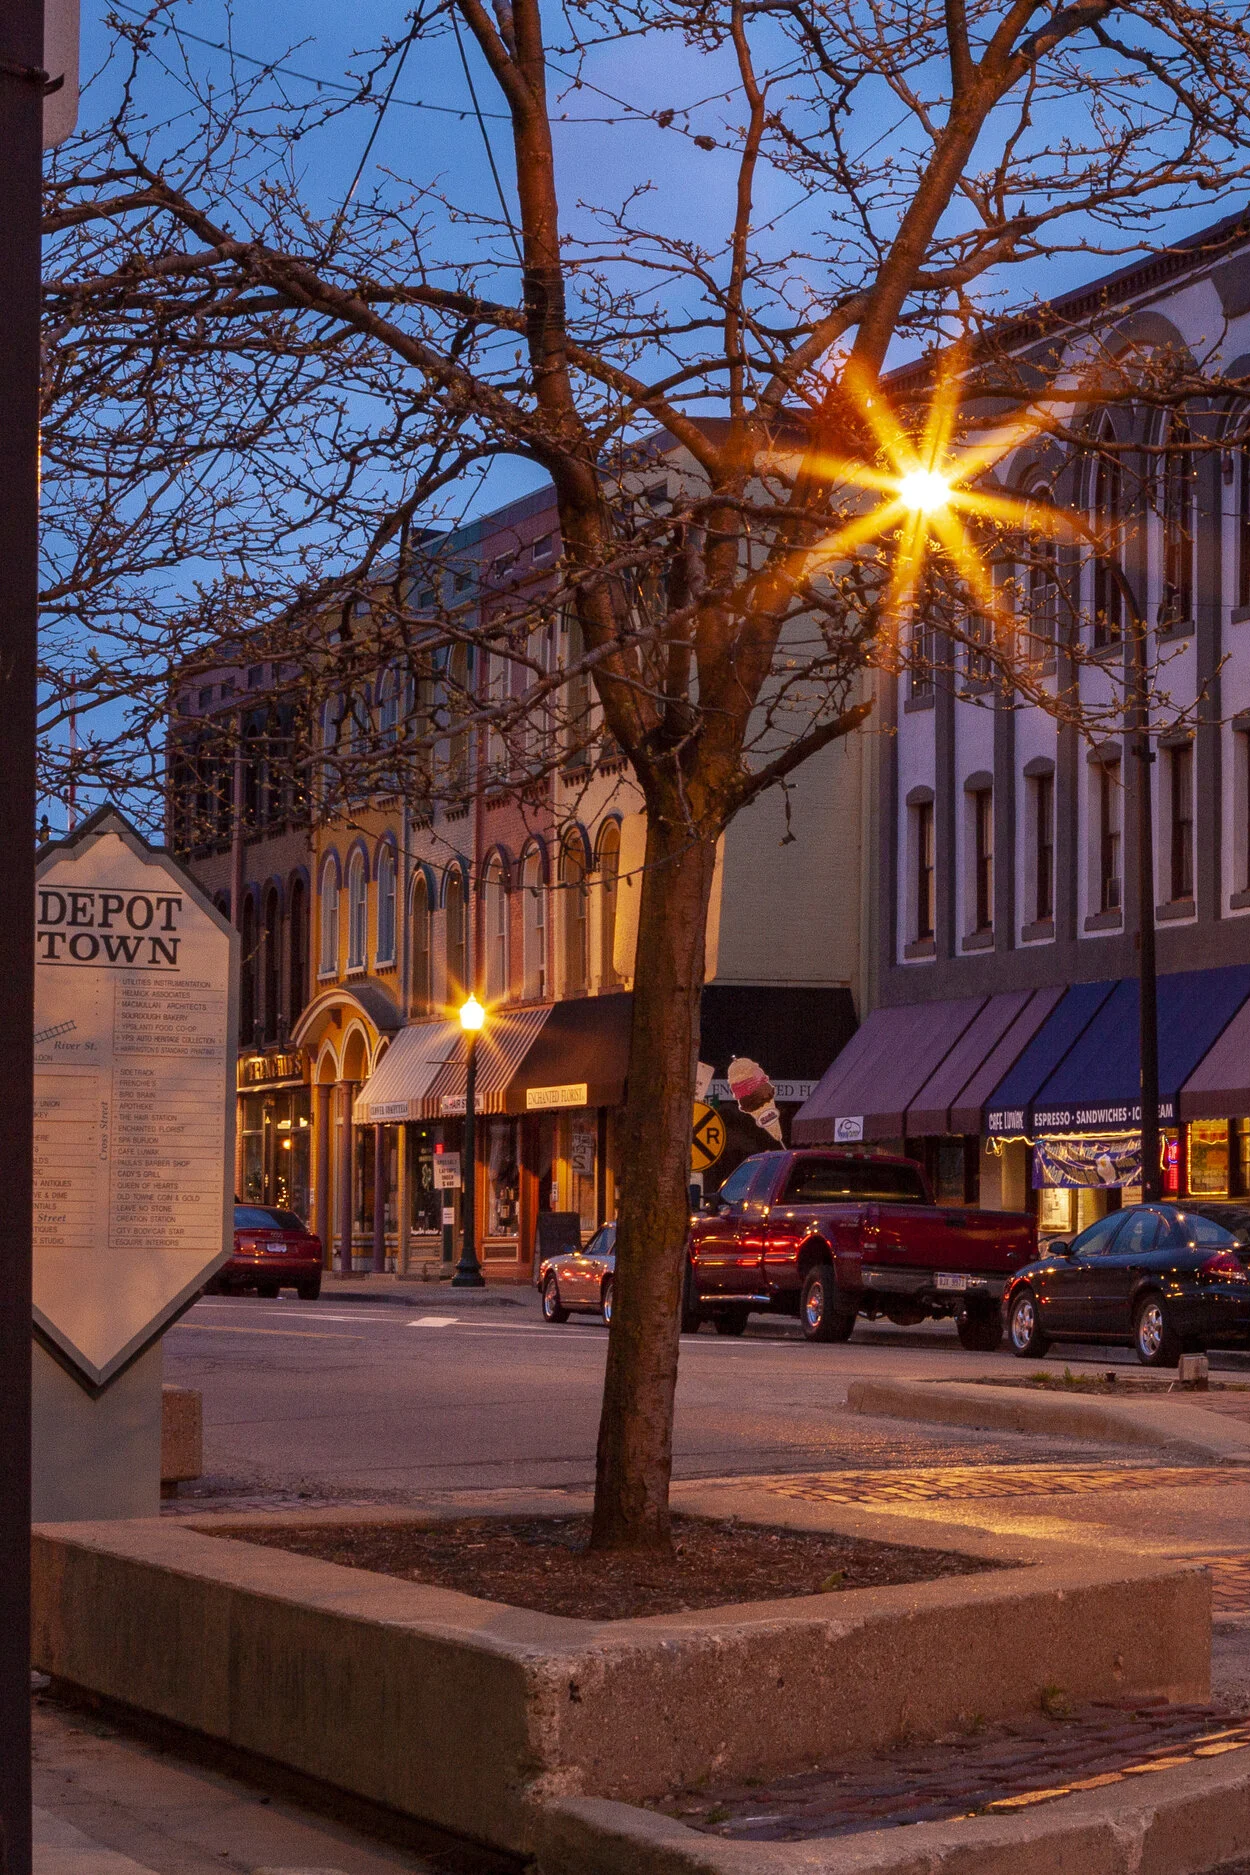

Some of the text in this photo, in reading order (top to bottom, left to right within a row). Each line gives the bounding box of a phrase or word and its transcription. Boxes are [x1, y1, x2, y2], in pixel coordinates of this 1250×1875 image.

[37, 890, 183, 931] DEPOT
[36, 931, 181, 965] TOWN
[166, 1003, 207, 1011] ARCHITECTS
[54, 1040, 98, 1050] River St.
[528, 1090, 559, 1105] ENCHANTED
[988, 1111, 1003, 1130] CAFE
[1034, 1111, 1071, 1127] ESPRESSO
[1076, 1107, 1127, 1125] SANDWICHES
[1132, 1105, 1142, 1121] IC
[99, 1101, 109, 1160] Cross Street
[706, 1127, 720, 1145] R
[40, 1180, 72, 1188] ANTIQUES
[151, 1205, 172, 1213] STONE
[37, 1213, 67, 1222] Street
